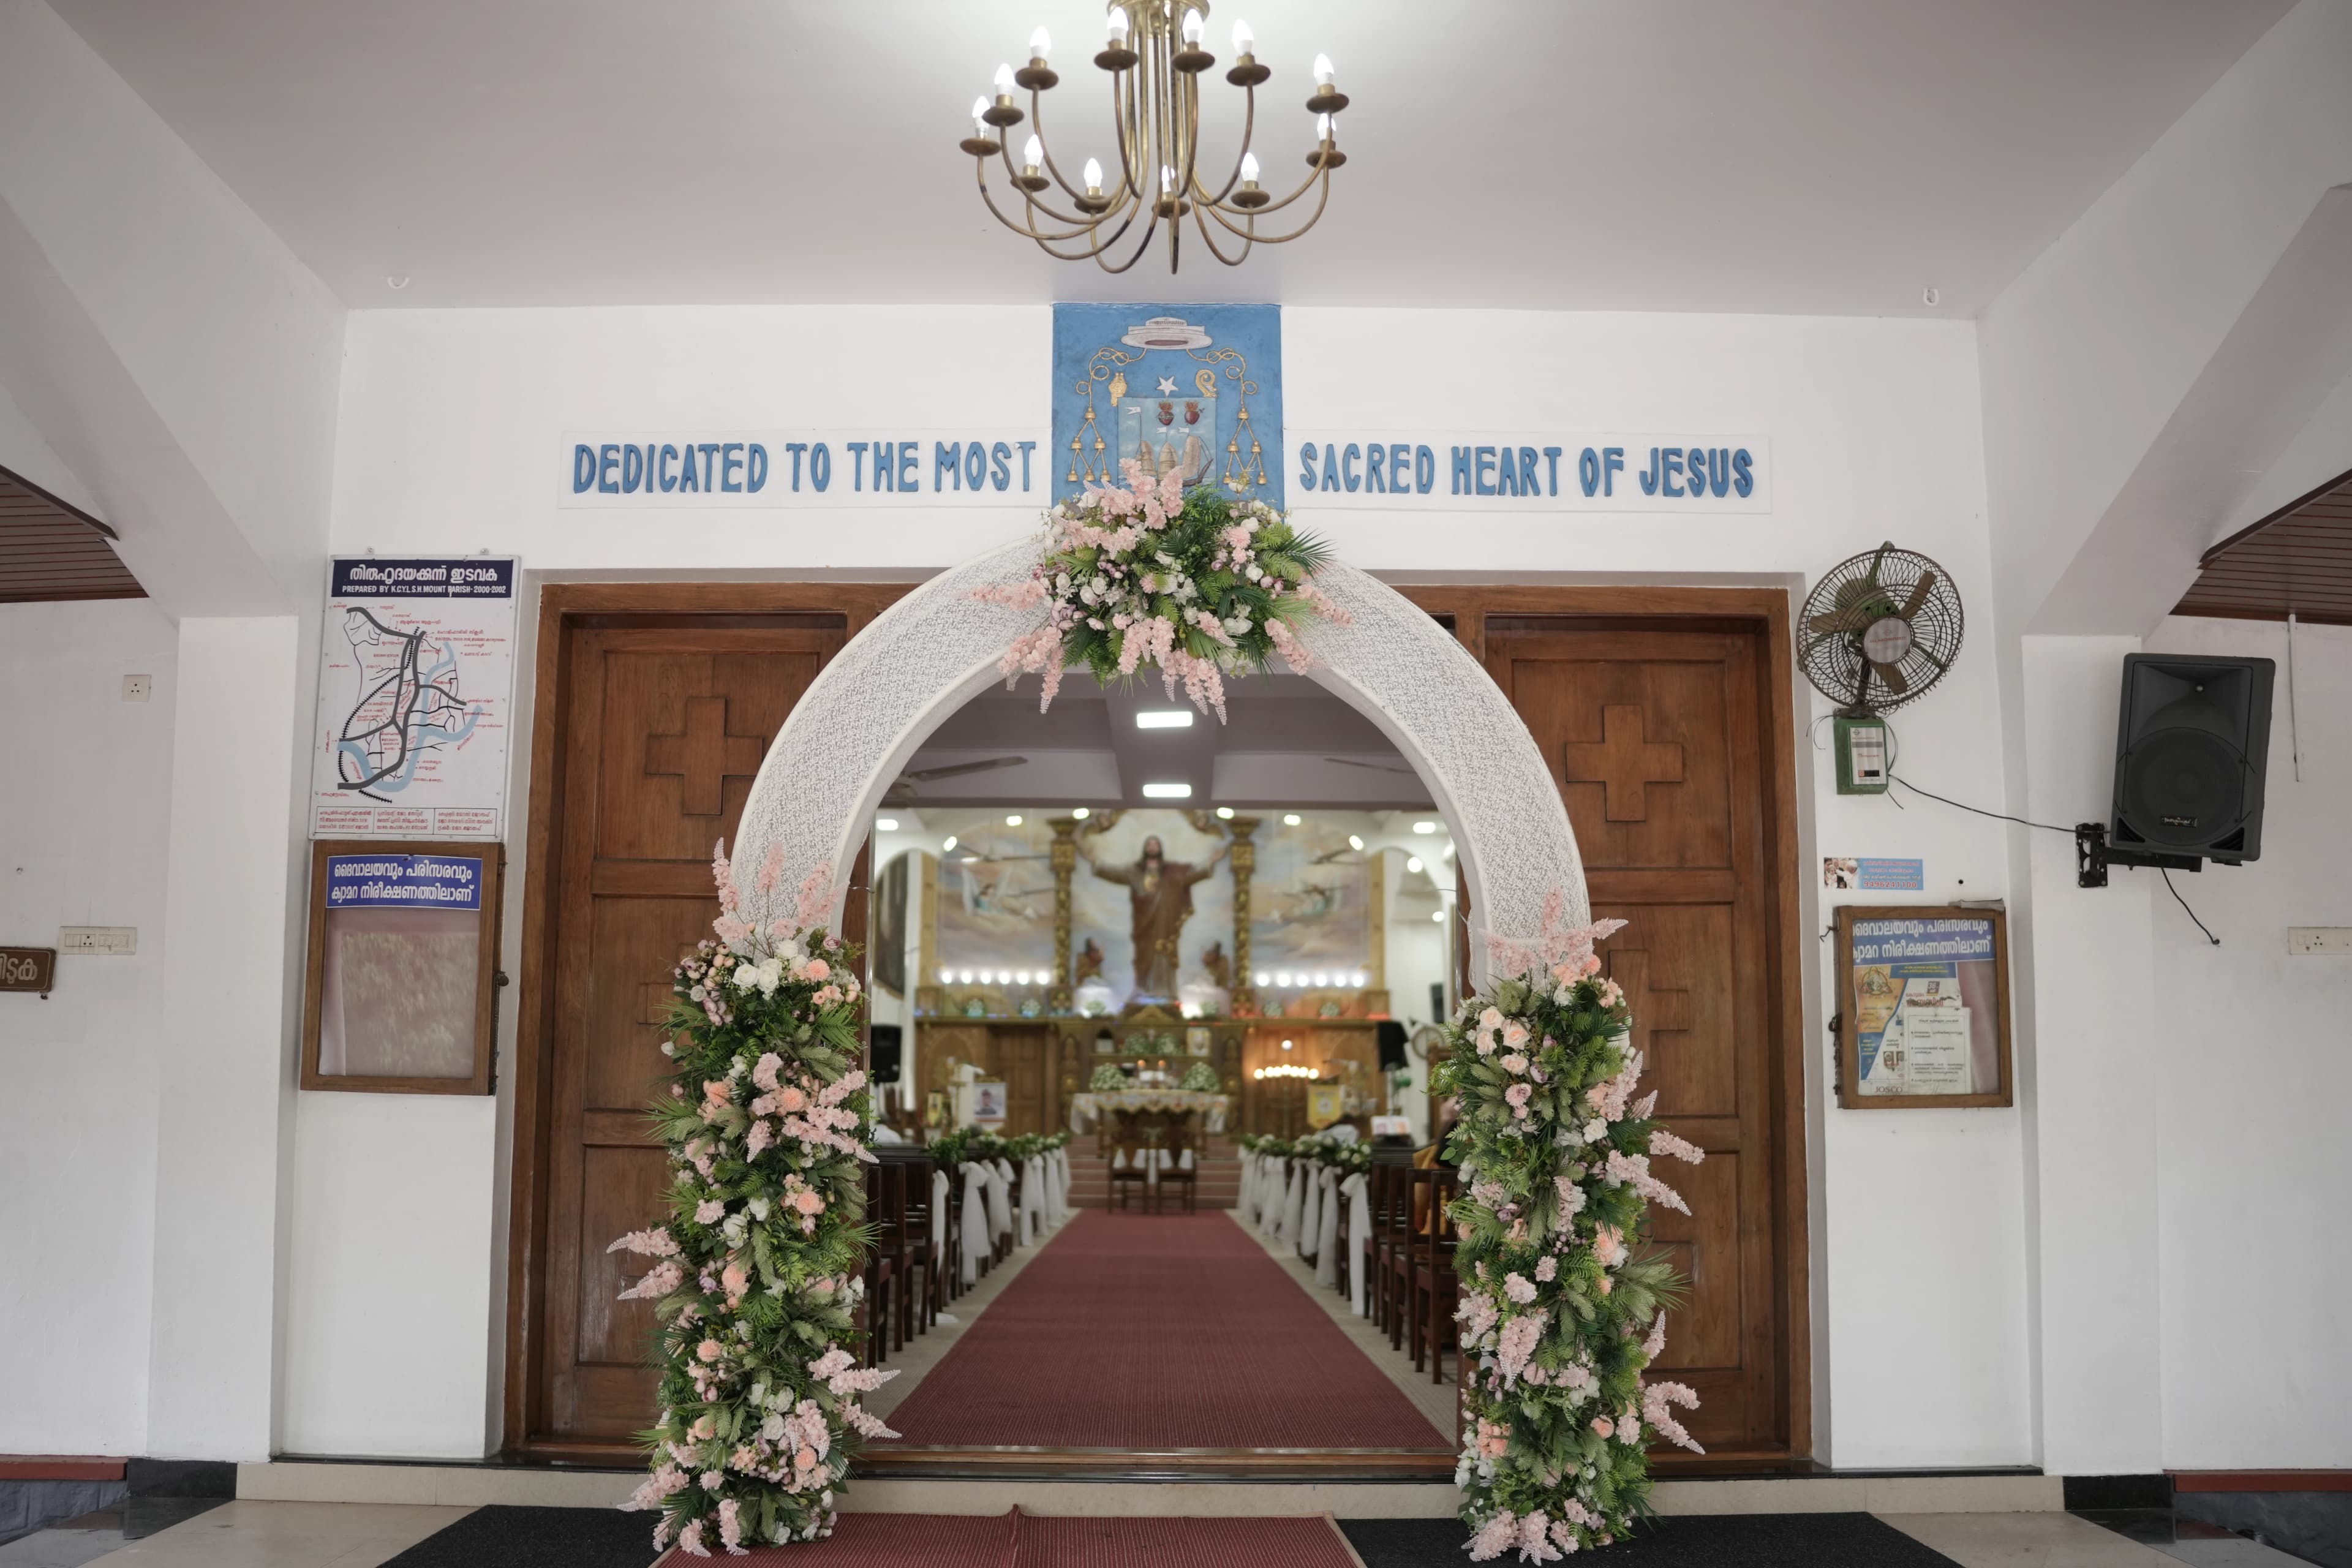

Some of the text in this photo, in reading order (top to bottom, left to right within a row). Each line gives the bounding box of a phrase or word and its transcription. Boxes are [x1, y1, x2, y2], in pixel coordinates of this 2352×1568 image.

[573, 442, 1036, 493] DEDICATED TO THE MOST
[1300, 443, 1754, 497] SACRED HEART OF JESUS
[450, 568, 498, 584] ഇടവക
[334, 859, 472, 883] ദൈവാലയവും പരിസരവും
[331, 881, 475, 903] ക്യാമറ നിരീക്ഷണത്തിലാണ്
[1882, 935, 1992, 958] നിരീക്ഷണത്തിലാണ്
